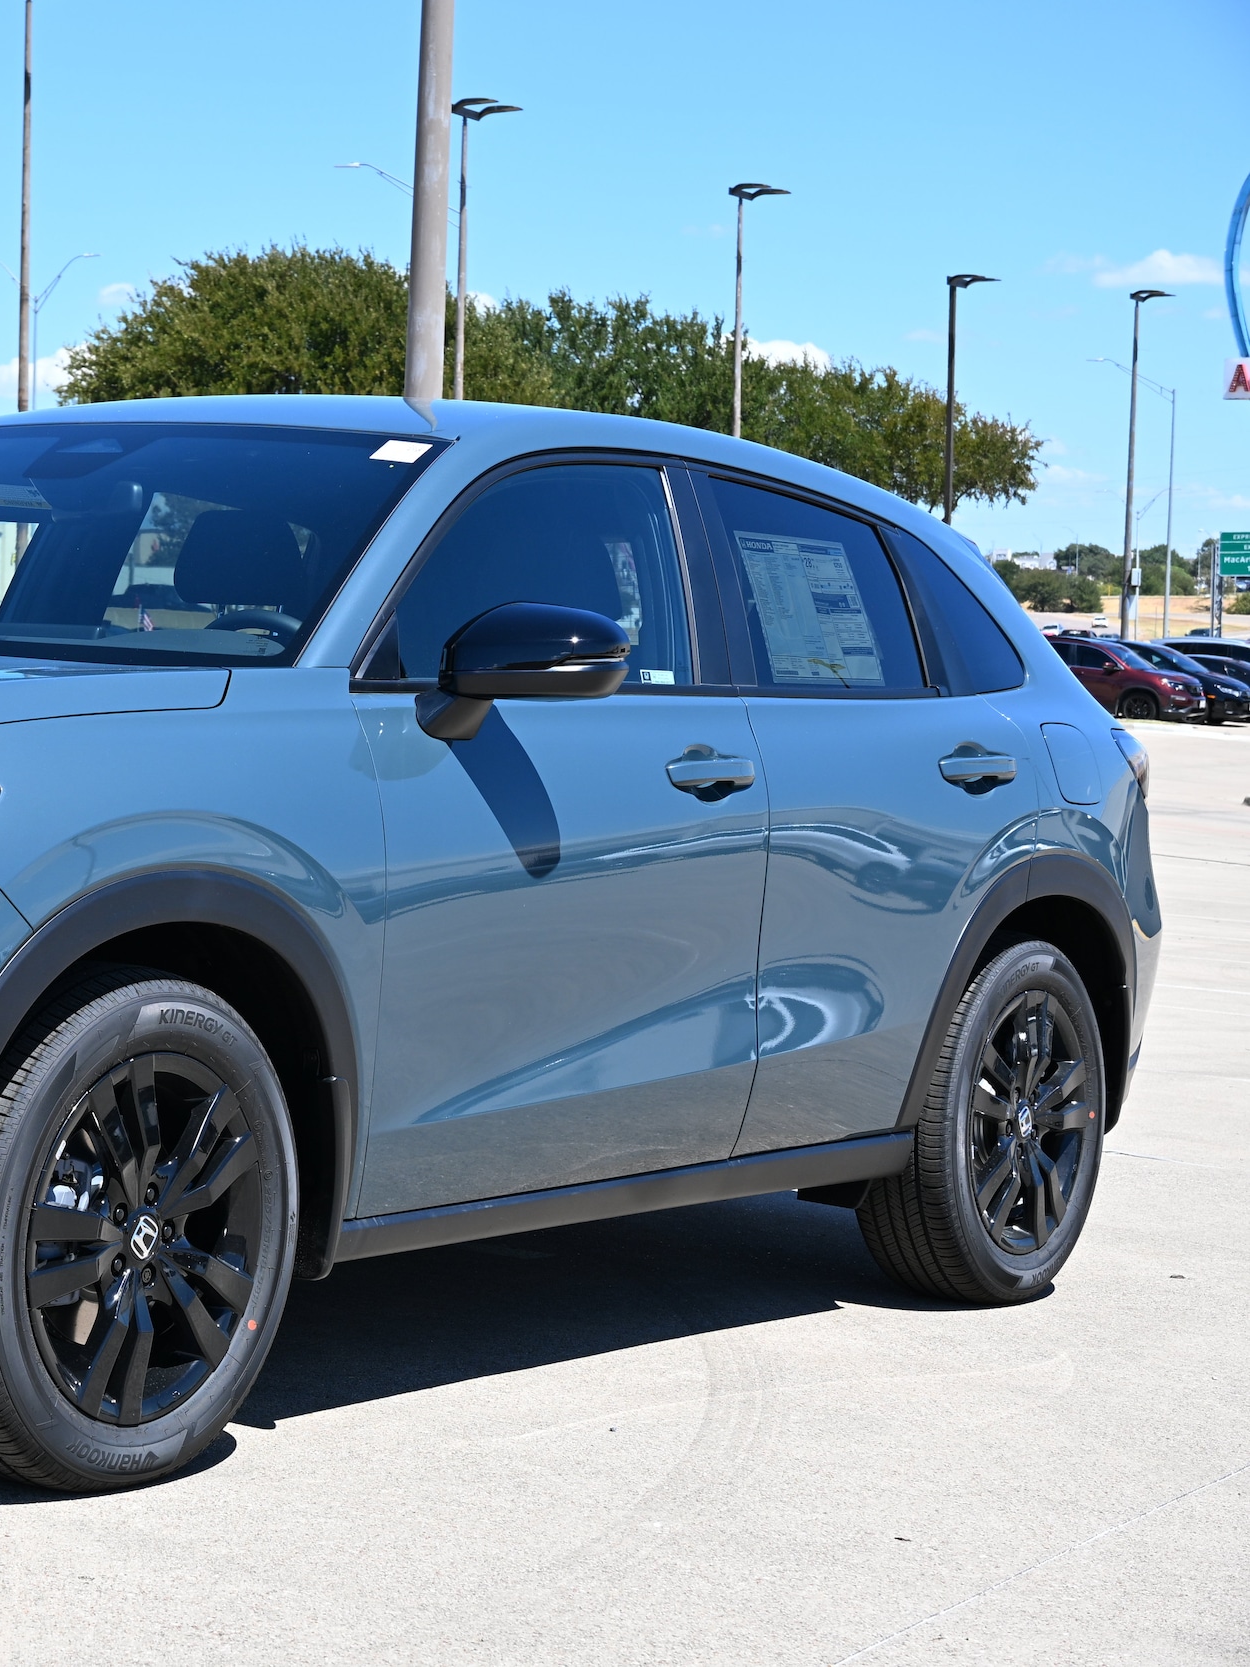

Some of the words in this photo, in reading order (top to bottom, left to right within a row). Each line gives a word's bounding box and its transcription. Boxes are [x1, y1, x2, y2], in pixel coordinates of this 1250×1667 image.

[1228, 363, 1250, 393] A
[745, 541, 773, 551] HONDA
[159, 1008, 224, 1035] KINERGY
[221, 1030, 238, 1047] GT
